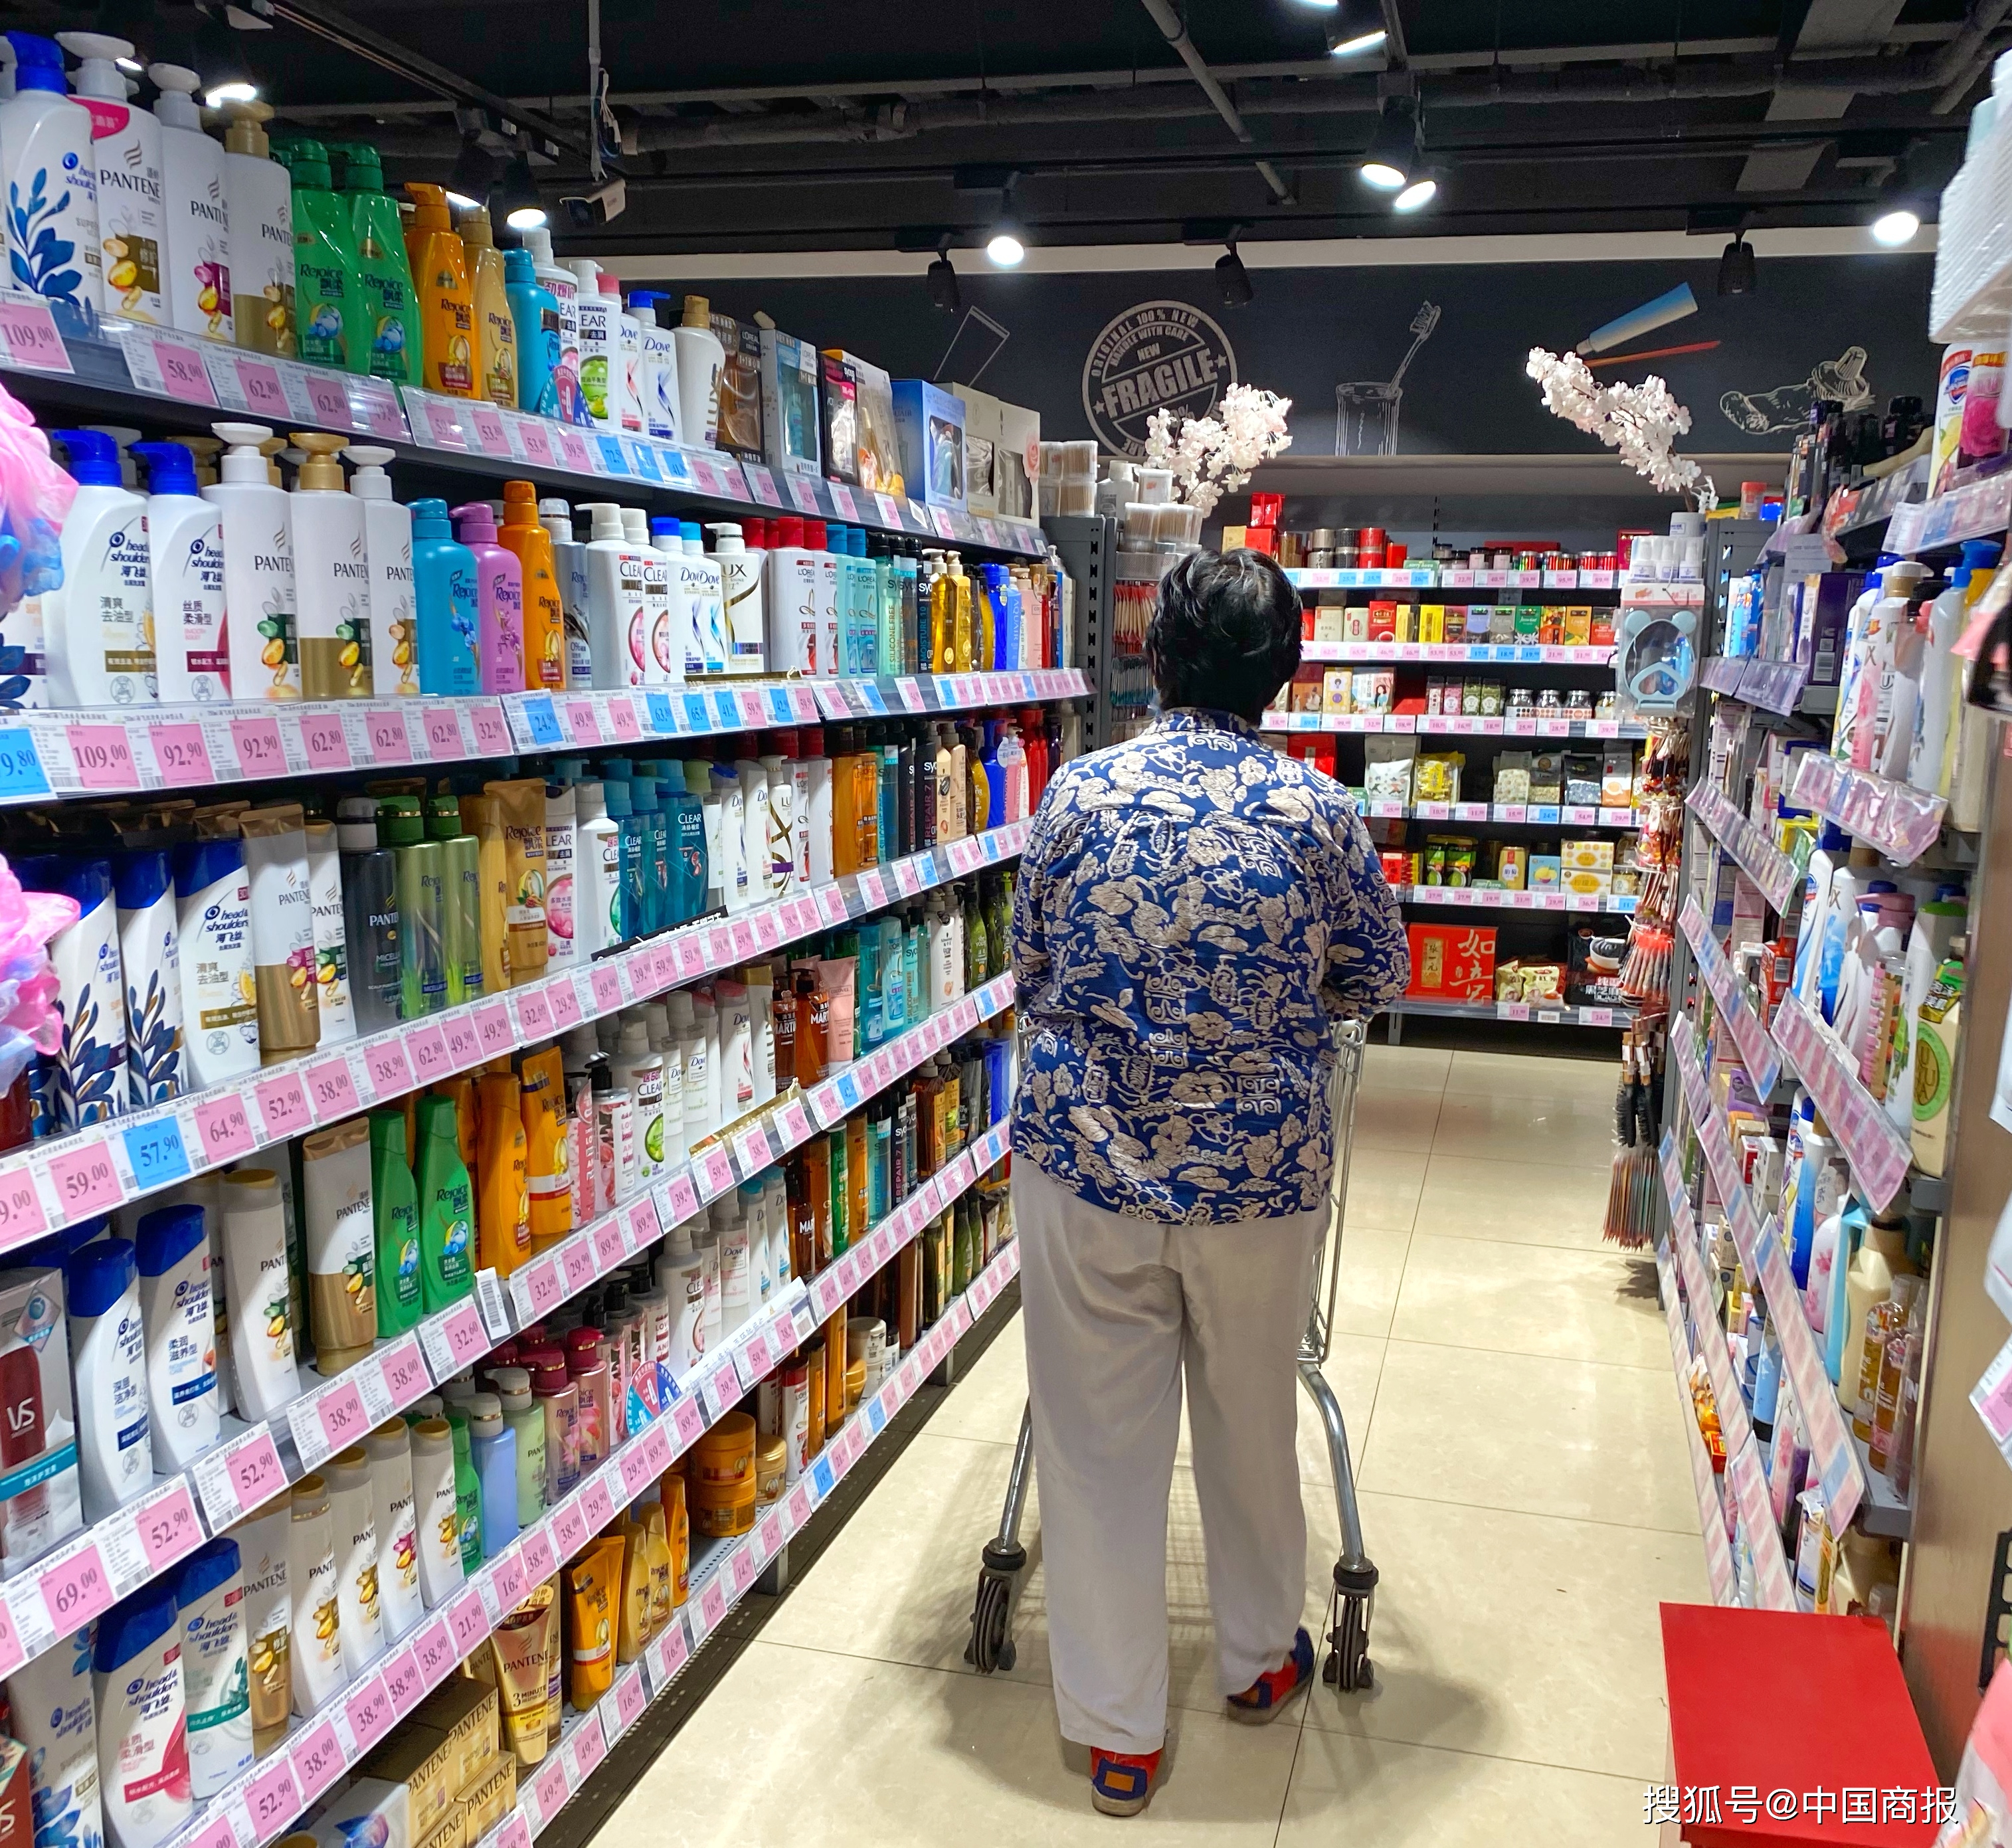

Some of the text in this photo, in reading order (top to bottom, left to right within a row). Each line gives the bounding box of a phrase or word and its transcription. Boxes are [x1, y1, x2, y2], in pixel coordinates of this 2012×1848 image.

[100, 168, 160, 199] PANTENE
[300, 264, 343, 279] Rejoice
[365, 273, 403, 291] Rejoice
[442, 299, 471, 314] Rejoice
[1137, 310, 1165, 325] 100%
[1172, 309, 1200, 327] NEW
[489, 312, 511, 327] Rejoice
[5, 322, 56, 352] 109.00
[1138, 325, 1162, 339] WITH
[644, 336, 670, 353] Dove
[1137, 343, 1161, 361] NEW
[168, 359, 203, 381] 58.00
[249, 379, 279, 400] 62.80
[1102, 349, 1218, 418] FRAGILE
[699, 571, 719, 585] Dove
[453, 583, 478, 599] Rejoice
[496, 587, 520, 602] Rejoice
[539, 597, 559, 608] Rejoice
[101, 597, 123, 609] 清爽
[183, 601, 203, 612] 丝质
[101, 611, 133, 622] 去油型
[183, 613, 213, 625] 柔滑型
[478, 720, 502, 740] 32.90
[534, 712, 556, 731] 24.90
[575, 709, 593, 728] 49.80
[616, 711, 634, 727] 49.90
[312, 730, 341, 753] 62.80
[376, 726, 403, 748] 62.80
[432, 723, 457, 743] 62.80
[74, 744, 127, 769] 109.00
[164, 741, 202, 767] 92.90
[243, 735, 277, 759] 92.90
[678, 812, 701, 824] CLEAR
[505, 824, 541, 840] Rejoice
[685, 945, 700, 963] 59.90
[197, 963, 219, 973] 清爽
[198, 970, 229, 984] 去油型
[634, 964, 651, 983] 39.90
[599, 978, 616, 996] 49.90
[555, 992, 575, 1014] 29.90
[525, 1004, 546, 1026] 32.60
[484, 1018, 506, 1041] 49.90
[418, 1041, 443, 1065] 62.80
[451, 1030, 474, 1054] 49.90
[376, 1055, 404, 1082] 38.90
[318, 1075, 347, 1103] 38.00
[638, 1081, 662, 1095] CLEAR
[269, 1090, 301, 1119] 52.90
[210, 1111, 244, 1143] 64.90
[140, 1135, 179, 1167] 57.90
[752, 1139, 765, 1158] 38.90
[66, 1162, 108, 1199] 59.00
[713, 1159, 727, 1180] 59.90
[436, 1185, 468, 1202] Rejoice
[675, 1186, 690, 1208] 39.90
[337, 1198, 370, 1220] PANTENE
[636, 1213, 654, 1234] 89.90
[600, 1232, 619, 1255] 89.90
[724, 1246, 744, 1257] Dove
[570, 1253, 590, 1278] 29.90
[571, 1253, 589, 1278] 29.90
[535, 1274, 555, 1301] 32.60
[169, 1336, 189, 1351] 柔润
[454, 1321, 478, 1350] 32.60
[169, 1344, 198, 1362] 滋养型
[391, 1359, 418, 1390] 38.00
[328, 1398, 358, 1432] 38.90
[682, 1407, 696, 1432] 89.90
[648, 1438, 666, 1463] 89.90
[240, 1453, 273, 1489] 52.90
[627, 1456, 644, 1481] 29.90
[588, 1492, 607, 1520] 29.90
[152, 1509, 188, 1549] 52.90
[560, 1516, 581, 1544] 38.00
[527, 1542, 549, 1574] 38.00
[56, 1567, 97, 1613] 69.00
[243, 1569, 287, 1596] PANTENE
[189, 1621, 238, 1643] shoulders
[458, 1604, 481, 1638] 21.90
[422, 1636, 447, 1671] 38.90
[503, 1649, 549, 1673] PANTENE
[128, 1680, 178, 1707] shoulders
[389, 1665, 416, 1704] 38.90
[513, 1684, 547, 1707] 3 MINUTE
[622, 1684, 640, 1712] 16.90
[357, 1693, 385, 1732] 38.90
[449, 1693, 496, 1742] PANTENE
[581, 1730, 600, 1760] 49.90
[304, 1738, 332, 1779] 38.00
[258, 1778, 291, 1820] 52.90
[466, 1764, 514, 1814] PANTENE
[543, 1773, 563, 1803] 49.90
